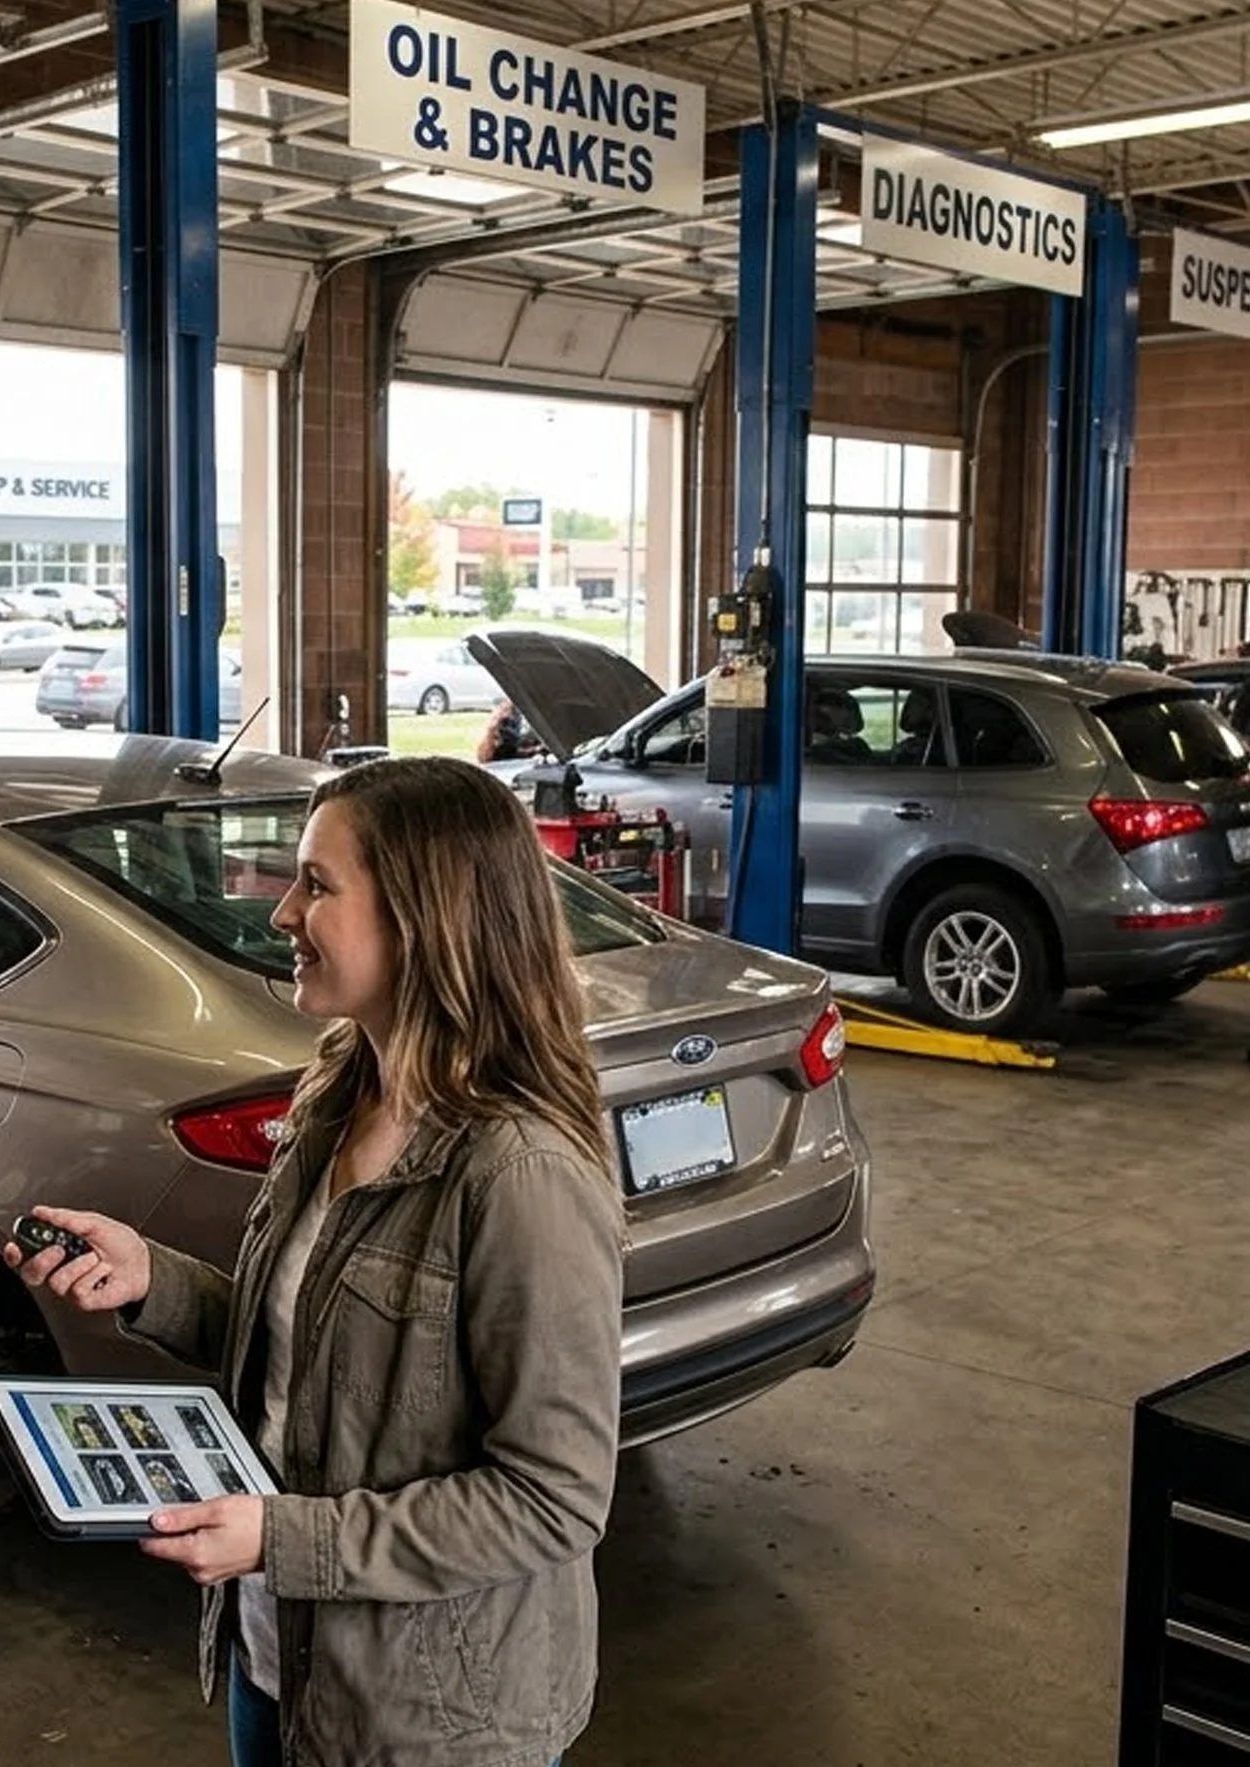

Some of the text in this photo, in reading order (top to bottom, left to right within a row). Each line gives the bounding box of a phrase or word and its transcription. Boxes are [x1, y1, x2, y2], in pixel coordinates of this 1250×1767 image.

[388, 24, 678, 141] OIL CHANGE
[414, 97, 653, 193] & BRAKES
[873, 167, 1076, 266] DIAGNOSTICS
[12, 478, 25, 496] &
[31, 479, 110, 499] SERVICE
